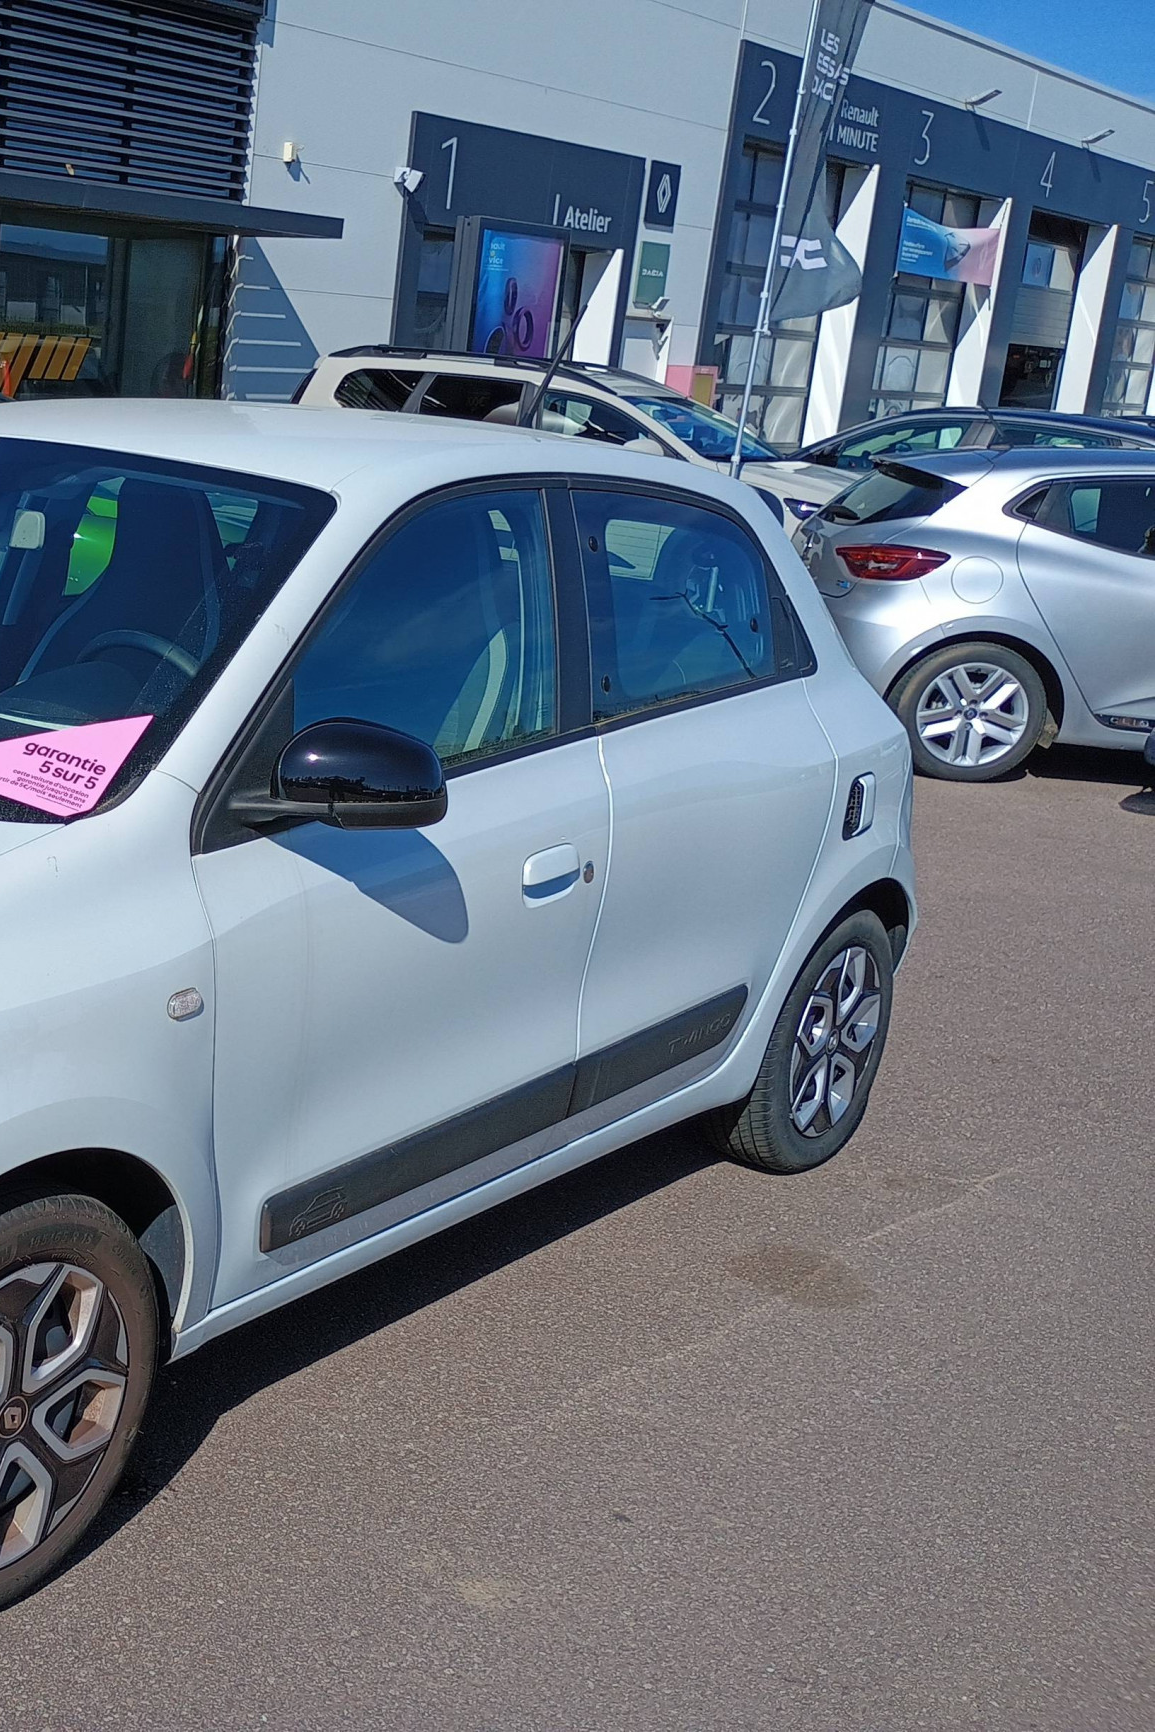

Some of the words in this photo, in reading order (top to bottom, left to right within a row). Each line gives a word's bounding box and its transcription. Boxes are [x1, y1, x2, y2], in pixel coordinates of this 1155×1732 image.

[820, 28, 841, 55] LES
[816, 52, 851, 86] ESSAS
[752, 60, 777, 125] 2
[811, 75, 836, 105] DACI
[840, 99, 880, 128] Renault
[836, 124, 879, 153] MINUTE
[914, 110, 935, 166] 3
[441, 136, 458, 210] 1
[1040, 151, 1056, 198] 4
[1138, 179, 1155, 224] 5
[563, 205, 612, 233] Atelier
[641, 268, 664, 278] DACIA
[1109, 716, 1150, 729] CLIO
[22, 741, 107, 776] garantie
[12, 769, 31, 778] cette
[30, 773, 54, 786] voiture
[53, 780, 90, 799] d'occasion
[16, 775, 45, 790] garantie
[73, 796, 86, 804] ans
[38, 760, 54, 774] 5
[53, 766, 86, 785] sur
[84, 775, 100, 790] 5
[47, 791, 83, 808] seulement
